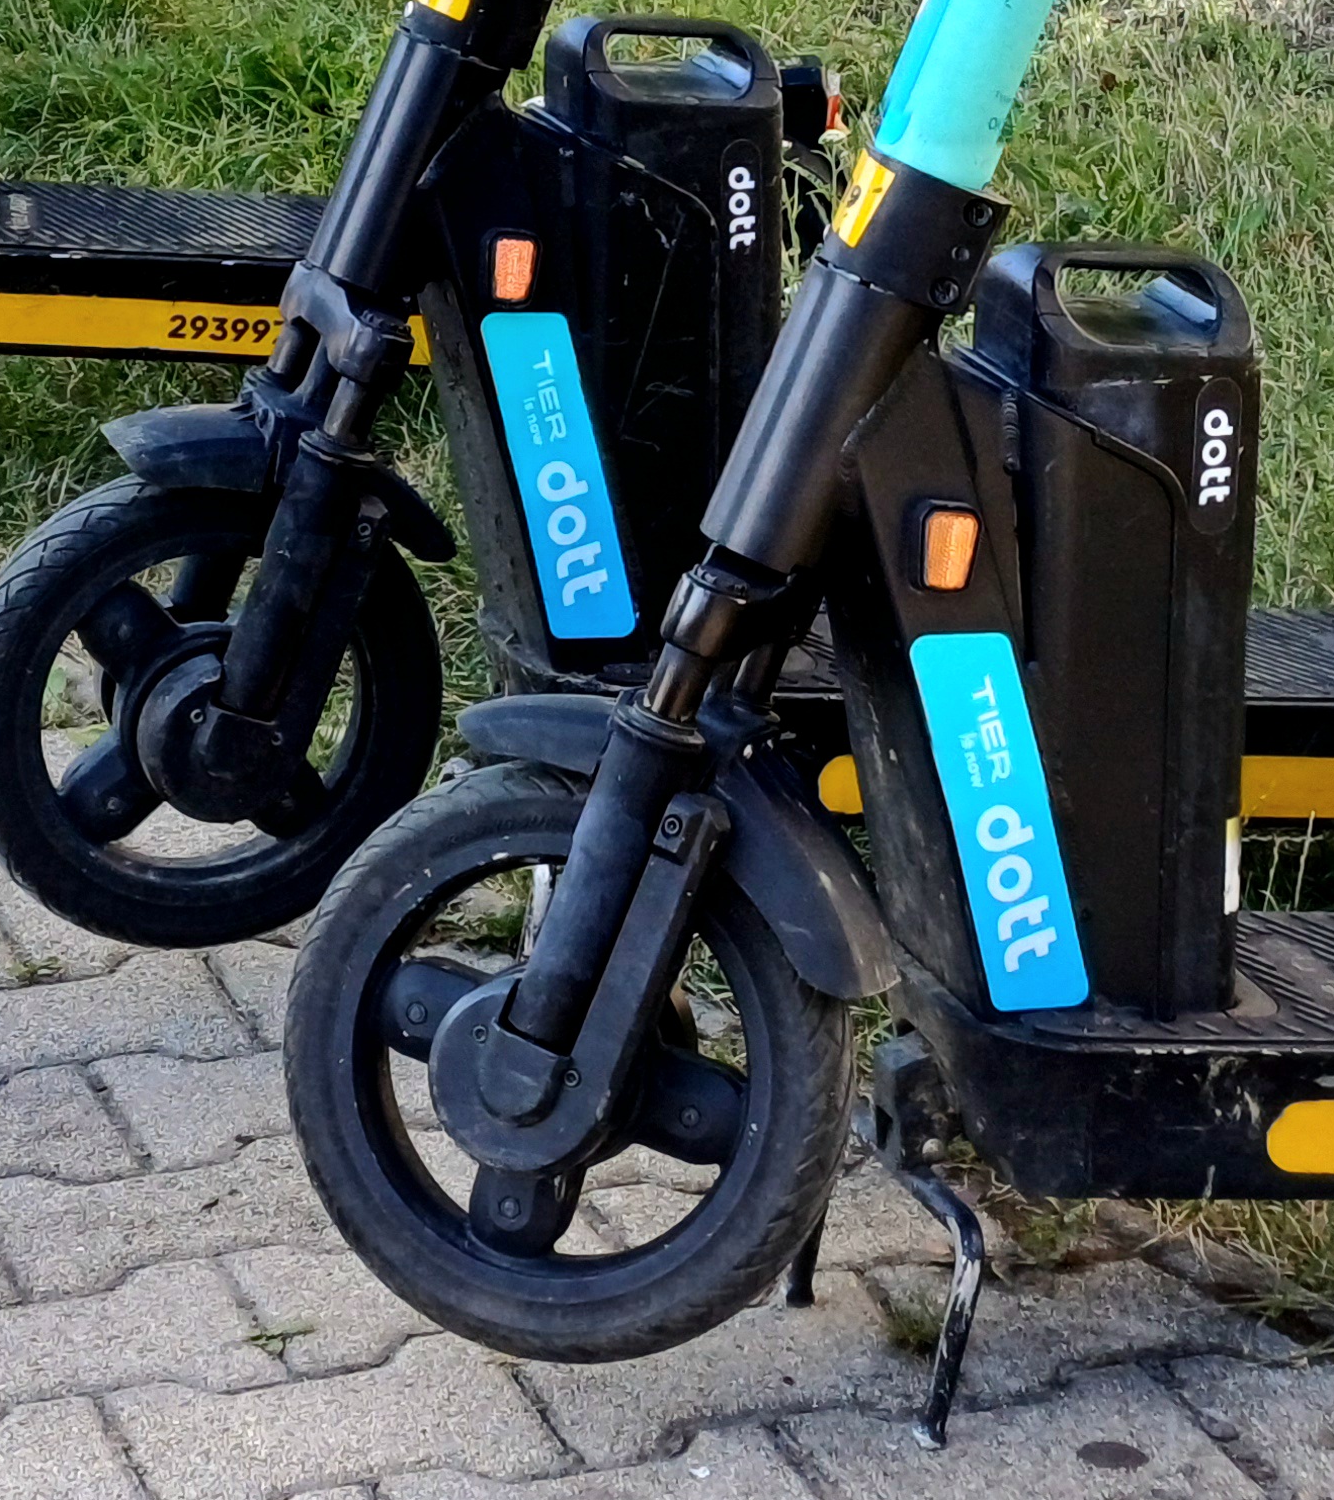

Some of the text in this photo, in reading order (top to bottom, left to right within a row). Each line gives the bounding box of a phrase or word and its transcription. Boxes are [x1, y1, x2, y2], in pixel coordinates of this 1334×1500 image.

[727, 166, 757, 251] dott
[526, 413, 544, 446] now
[532, 348, 568, 443] TIER
[1197, 408, 1234, 506] dott
[536, 460, 609, 607] dott
[964, 751, 985, 789] now
[971, 673, 1012, 784] TIER
[975, 804, 1058, 973] dott
